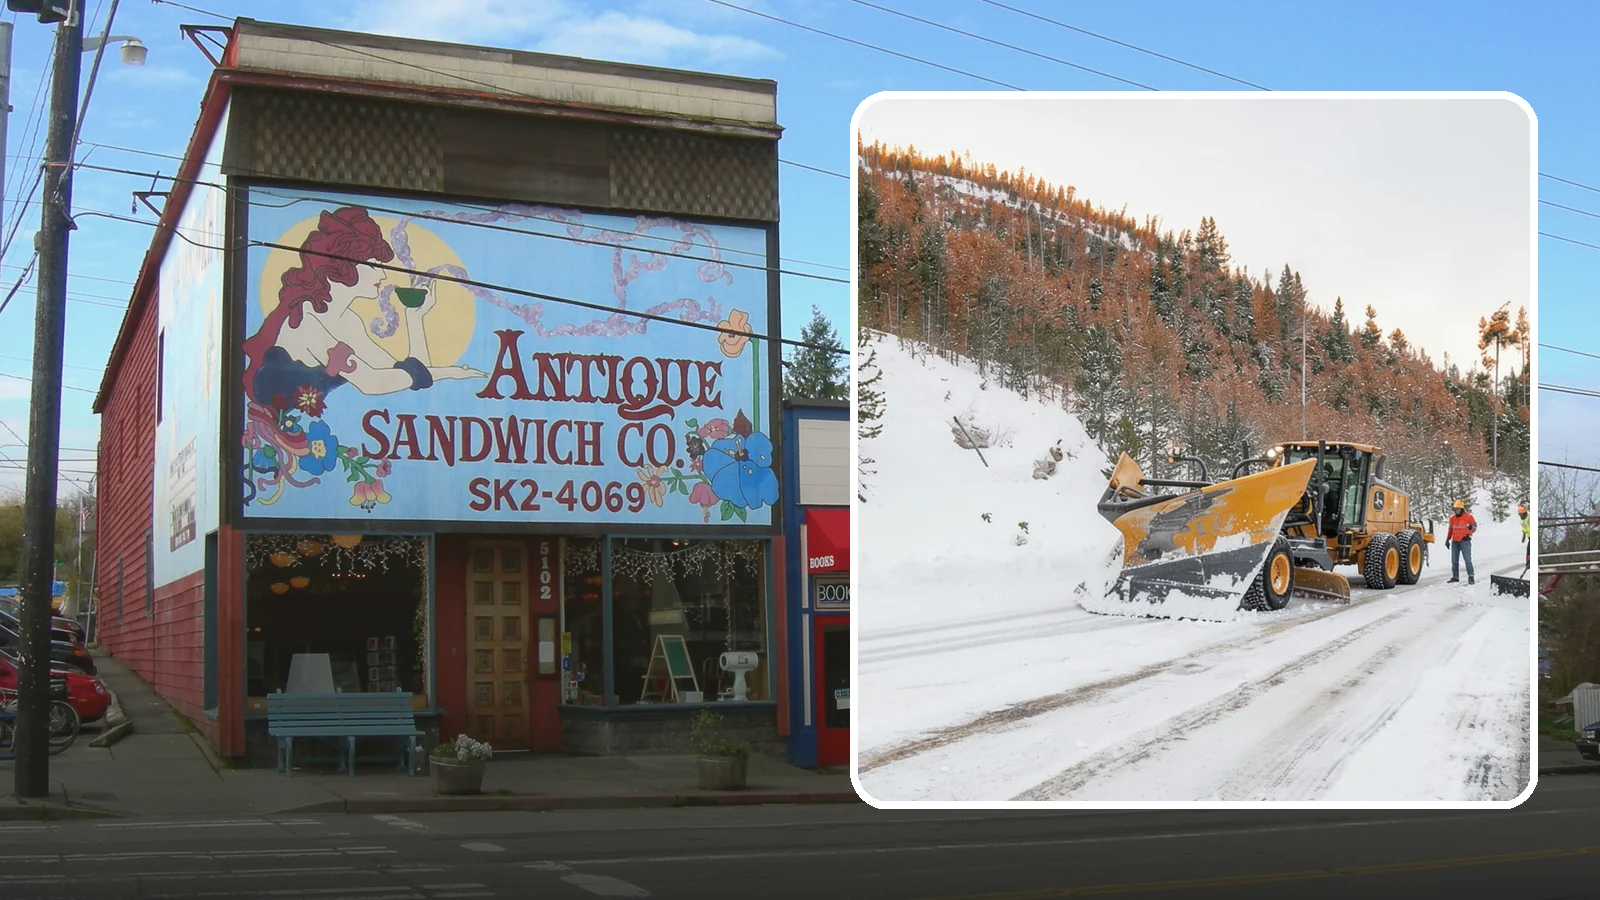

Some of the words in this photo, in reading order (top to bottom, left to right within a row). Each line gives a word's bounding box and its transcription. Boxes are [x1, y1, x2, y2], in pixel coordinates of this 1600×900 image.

[475, 328, 724, 421] ANTIQUE
[361, 408, 605, 467] SANDWICH
[617, 421, 685, 468] CO.
[468, 477, 646, 513] SK2-4069
[539, 541, 552, 600] 5102
[809, 555, 835, 569] BOOKS
